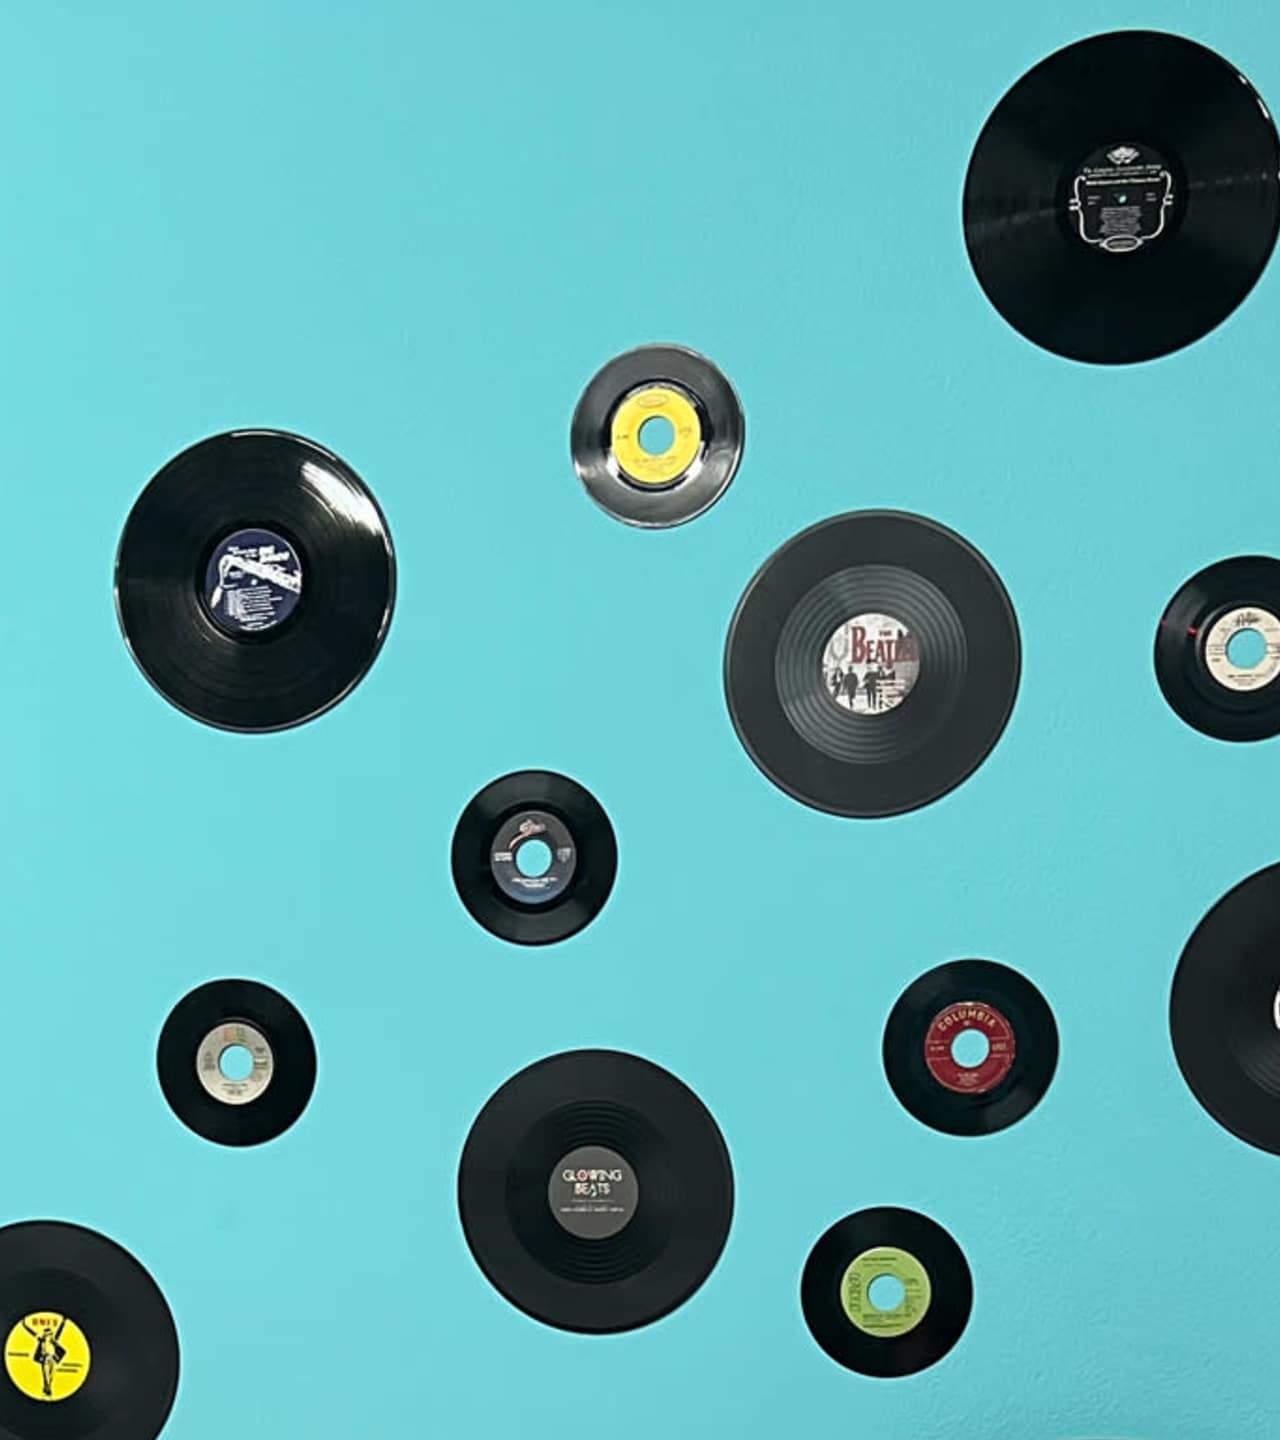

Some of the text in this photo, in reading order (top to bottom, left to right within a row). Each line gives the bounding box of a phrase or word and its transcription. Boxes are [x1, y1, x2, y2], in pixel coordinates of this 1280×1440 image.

[938, 1009, 996, 1031] COLUMBIA
[562, 1169, 623, 1182] GLOWING
[574, 1182, 611, 1197] BEATS
